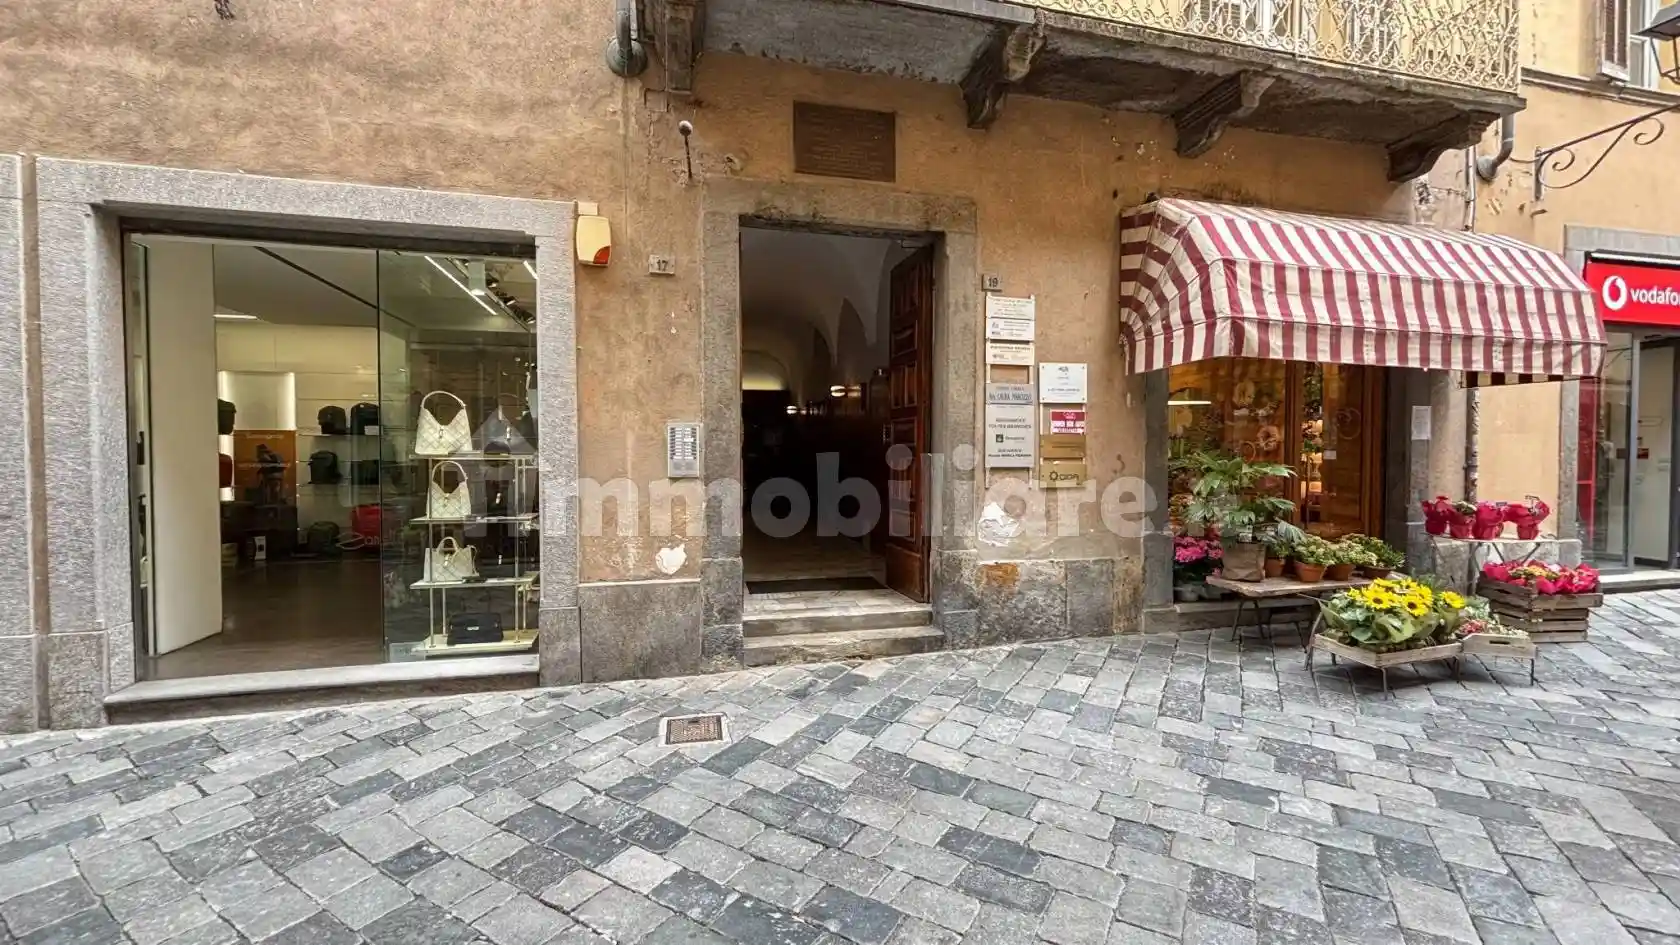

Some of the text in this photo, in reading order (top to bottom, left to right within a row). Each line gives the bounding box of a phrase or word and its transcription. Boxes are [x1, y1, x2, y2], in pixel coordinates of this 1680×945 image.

[657, 259, 669, 272] 17
[987, 277, 999, 288] 19
[1630, 286, 1680, 306] vodafo
